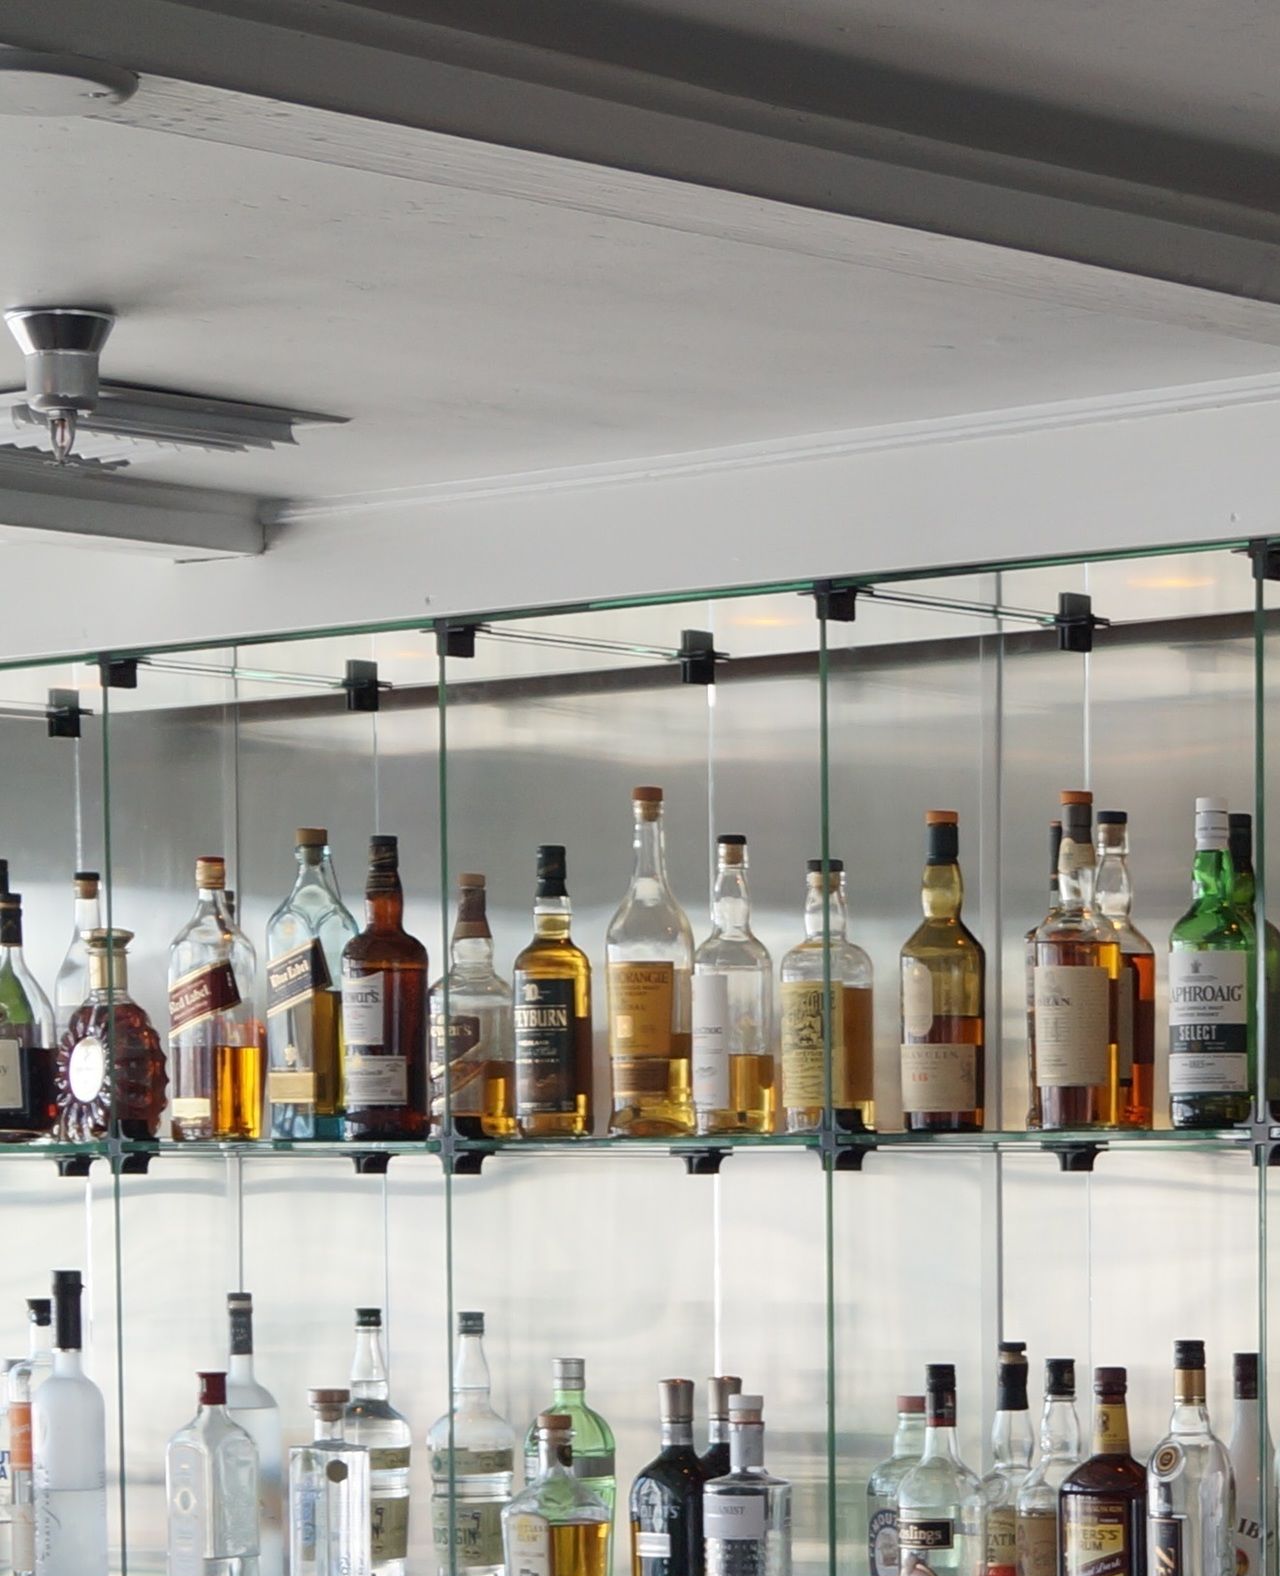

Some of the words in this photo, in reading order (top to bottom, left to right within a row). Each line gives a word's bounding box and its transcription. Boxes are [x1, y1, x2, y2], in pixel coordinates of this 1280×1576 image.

[287, 959, 310, 980] Label
[186, 984, 212, 1007] Label
[1171, 984, 1242, 1003] APHROAIG
[1178, 1025, 1217, 1041] SELECT
